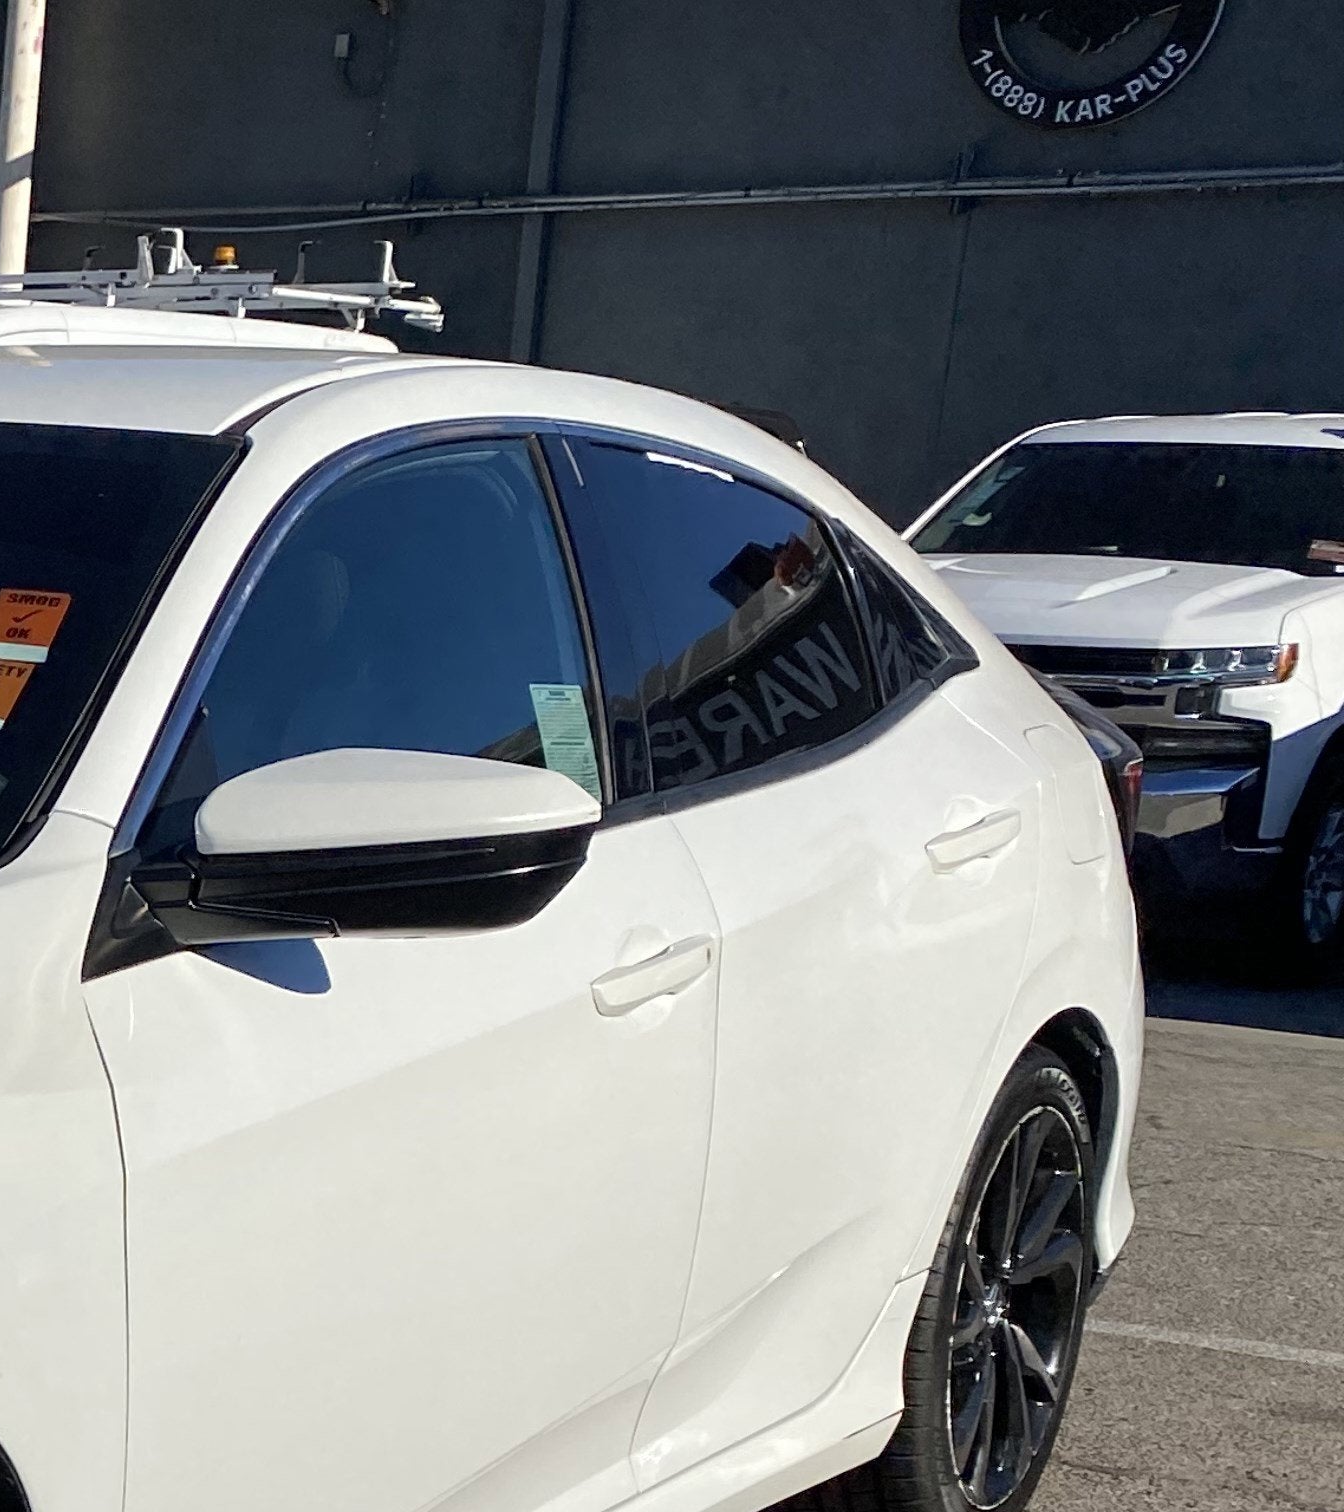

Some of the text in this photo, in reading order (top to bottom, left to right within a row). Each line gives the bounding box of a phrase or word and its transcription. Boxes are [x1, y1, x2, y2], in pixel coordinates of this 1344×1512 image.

[971, 43, 1189, 123] 1-(888) KAR-PLUS
[6, 593, 62, 608] SMOG
[5, 627, 31, 640] OK
